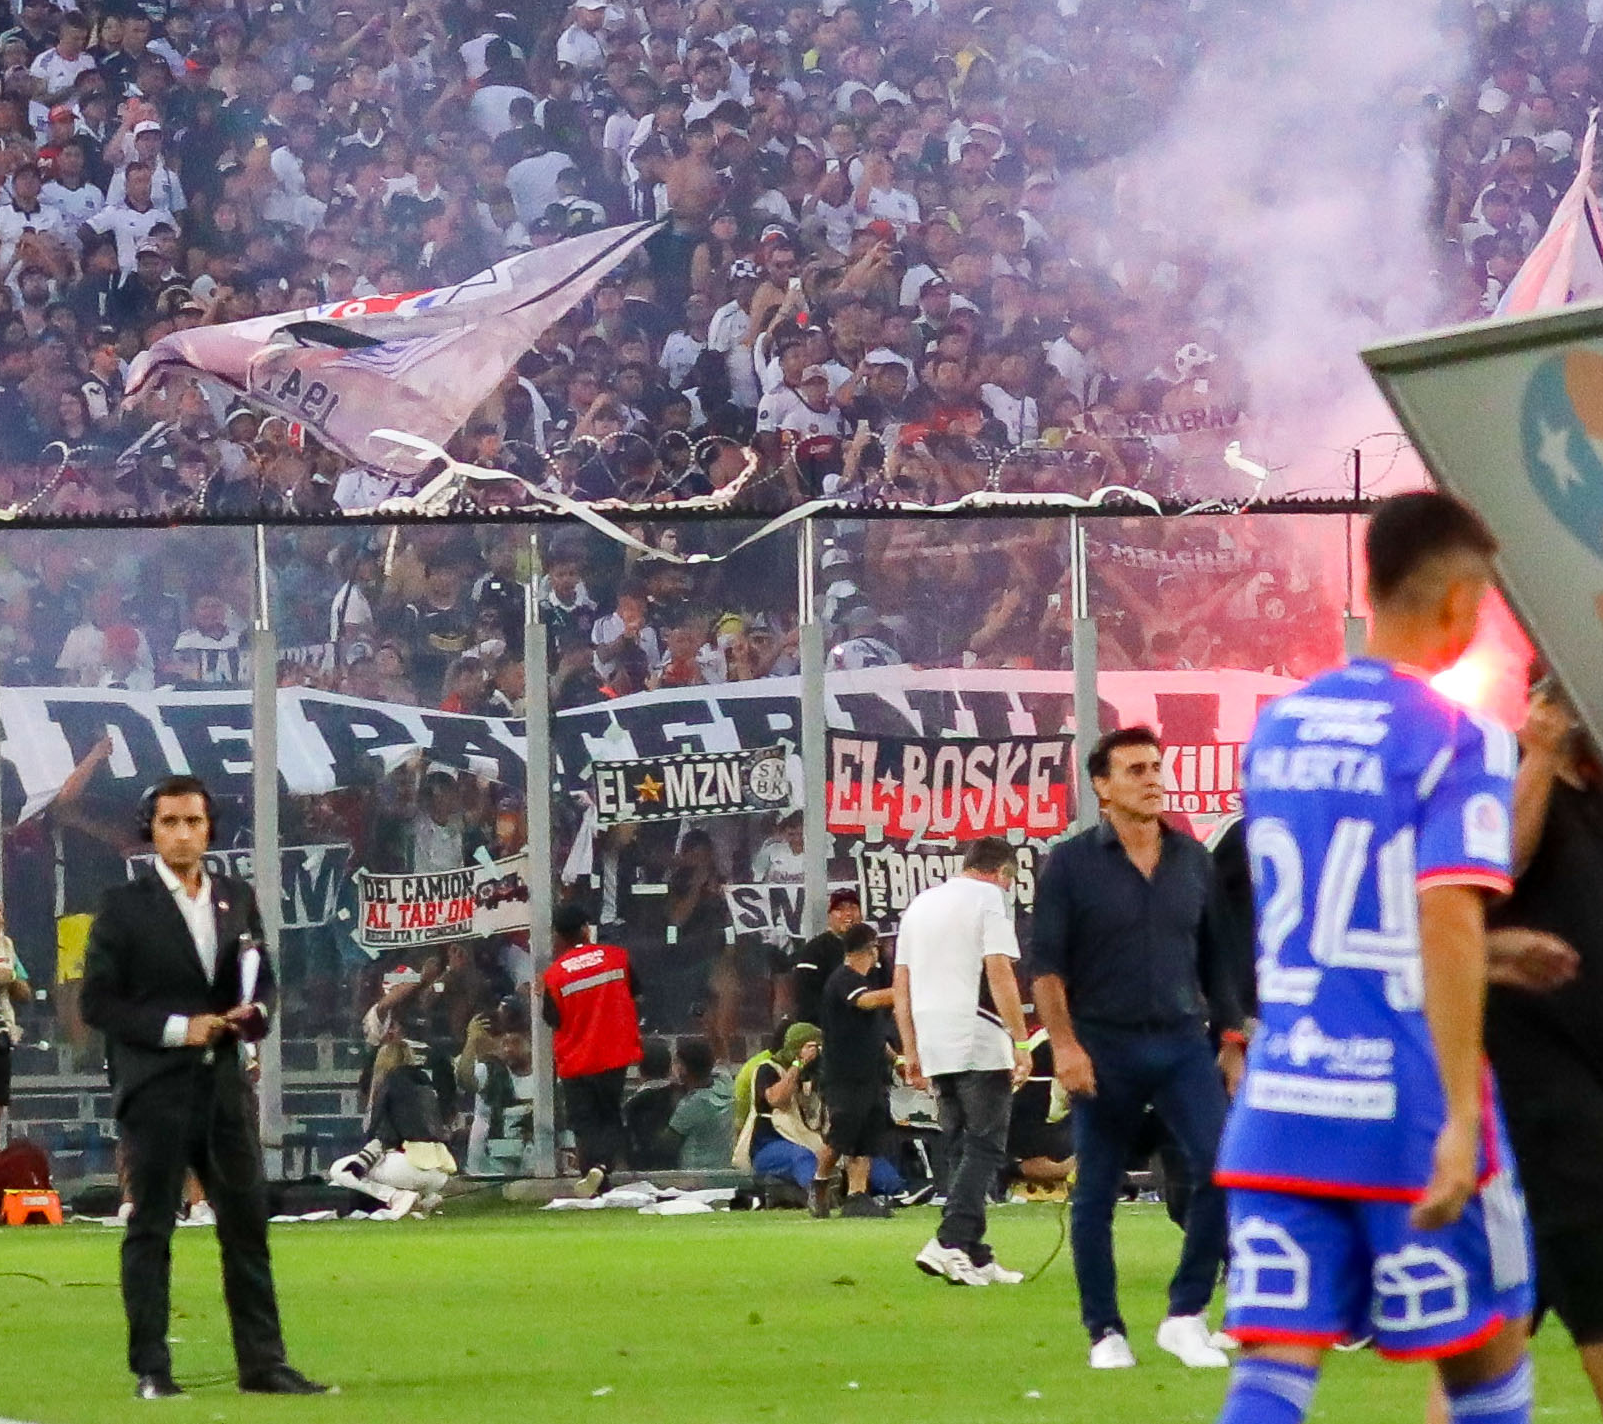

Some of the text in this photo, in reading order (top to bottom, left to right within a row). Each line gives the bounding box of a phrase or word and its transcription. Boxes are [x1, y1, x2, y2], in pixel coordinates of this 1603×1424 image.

[597, 760, 743, 815] EL MZN
[829, 737, 1065, 832] EL BOSKE
[363, 876, 396, 904] DEL
[366, 903, 391, 929] AL
[1245, 815, 1426, 1013] 24
